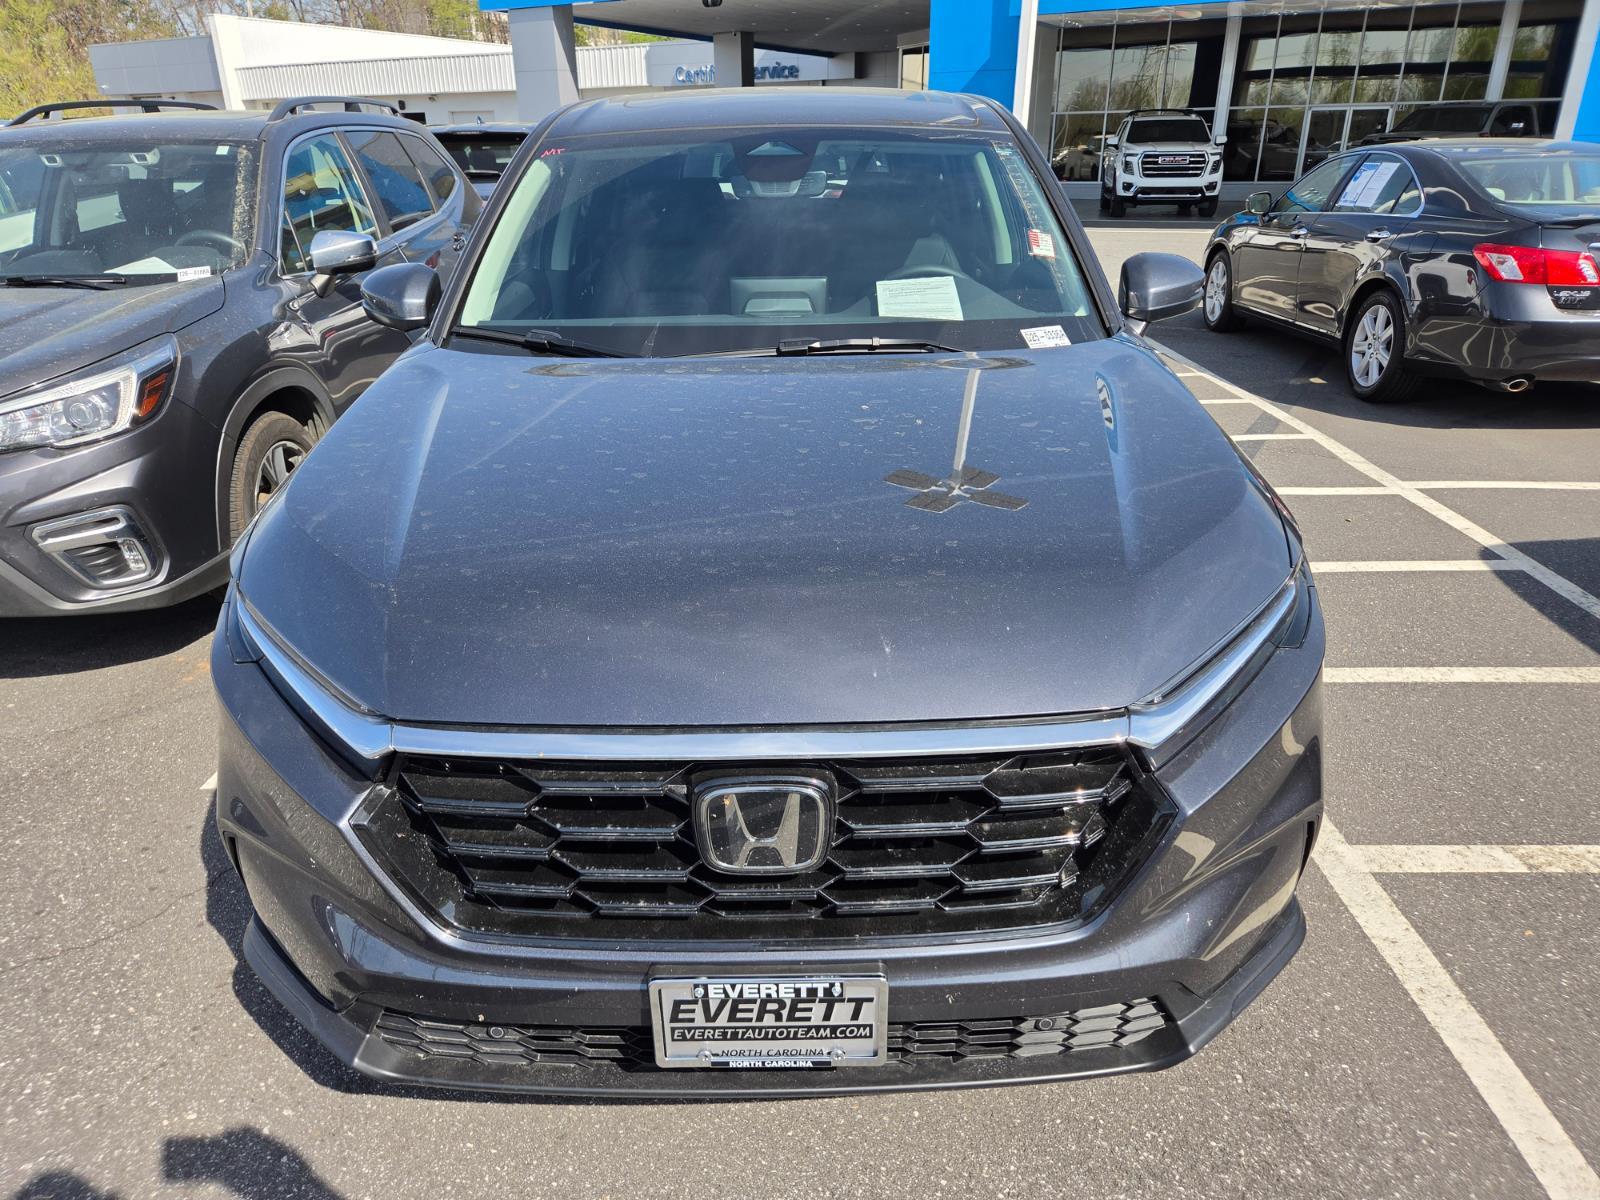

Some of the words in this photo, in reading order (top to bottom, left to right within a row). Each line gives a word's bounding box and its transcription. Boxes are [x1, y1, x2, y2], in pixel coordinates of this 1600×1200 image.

[754, 61, 799, 79] ervice
[708, 983, 829, 998] EVERETT
[669, 997, 875, 1024] EVERETT
[673, 1026, 871, 1040] EVERETTAUTOTEAM.COM
[721, 1049, 761, 1057] NORTH
[766, 1048, 824, 1056] CAROLINA
